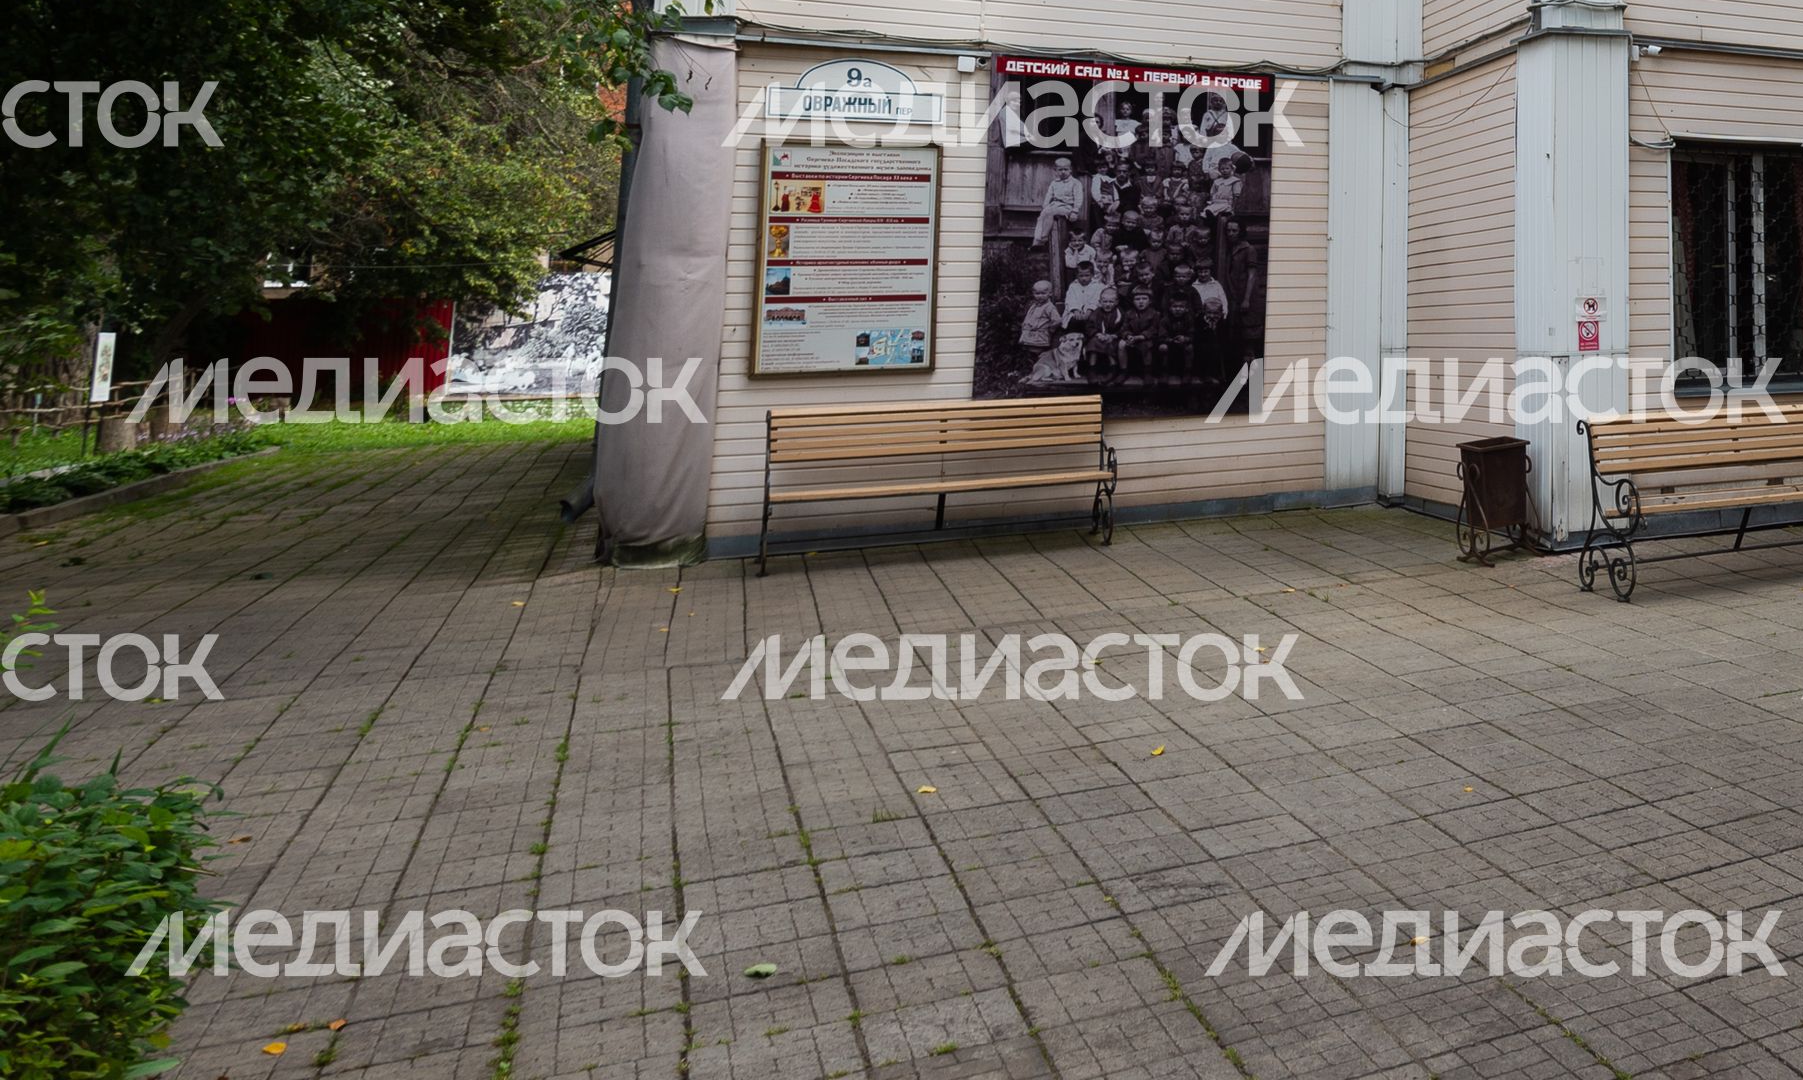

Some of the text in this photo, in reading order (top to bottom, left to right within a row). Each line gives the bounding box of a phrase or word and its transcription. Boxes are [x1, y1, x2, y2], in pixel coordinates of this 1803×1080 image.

[1005, 60, 1070, 76] ДЕТСКИЙ
[1075, 65, 1102, 78] САД
[1107, 68, 1129, 80] №1
[1144, 71, 1197, 86] ПЕРВЫЙ
[1202, 76, 1210, 86] В
[1214, 76, 1262, 90] ГОРОДЕ
[803, 94, 892, 115] ОВРАЖНЫЙ
